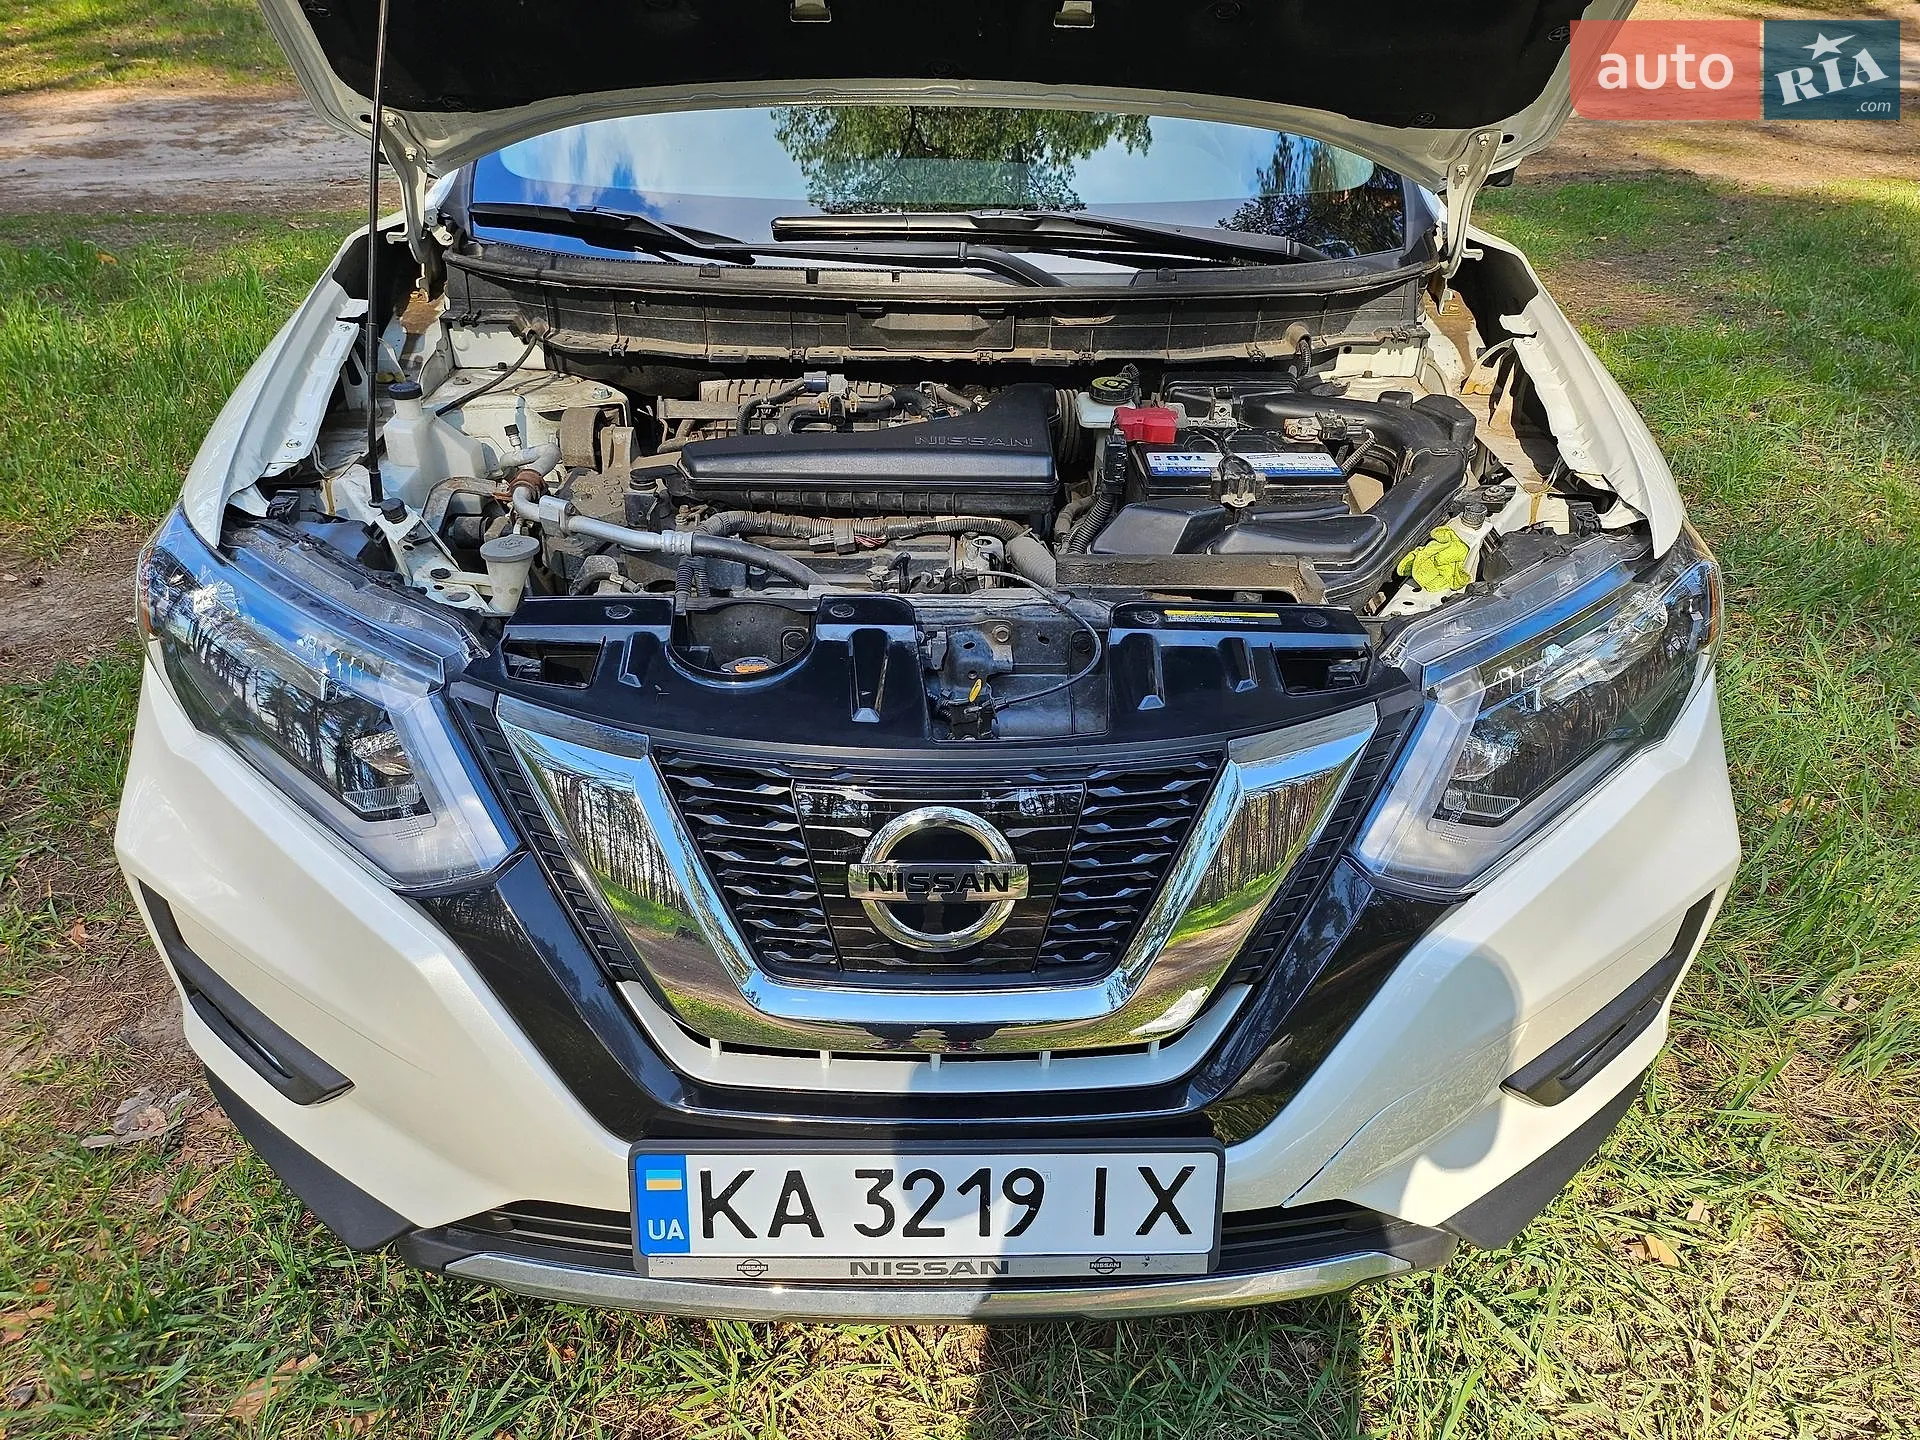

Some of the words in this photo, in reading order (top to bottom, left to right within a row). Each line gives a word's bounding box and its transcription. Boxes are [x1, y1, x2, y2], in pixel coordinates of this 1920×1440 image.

[914, 435, 1033, 447] NISSAN
[868, 872, 1009, 893] NISSAN
[699, 1168, 826, 1239] KA
[852, 1166, 1047, 1238] 3219
[1093, 1165, 1197, 1236] IX
[647, 1218, 685, 1241] UA
[850, 1260, 1010, 1277] NISSAN
